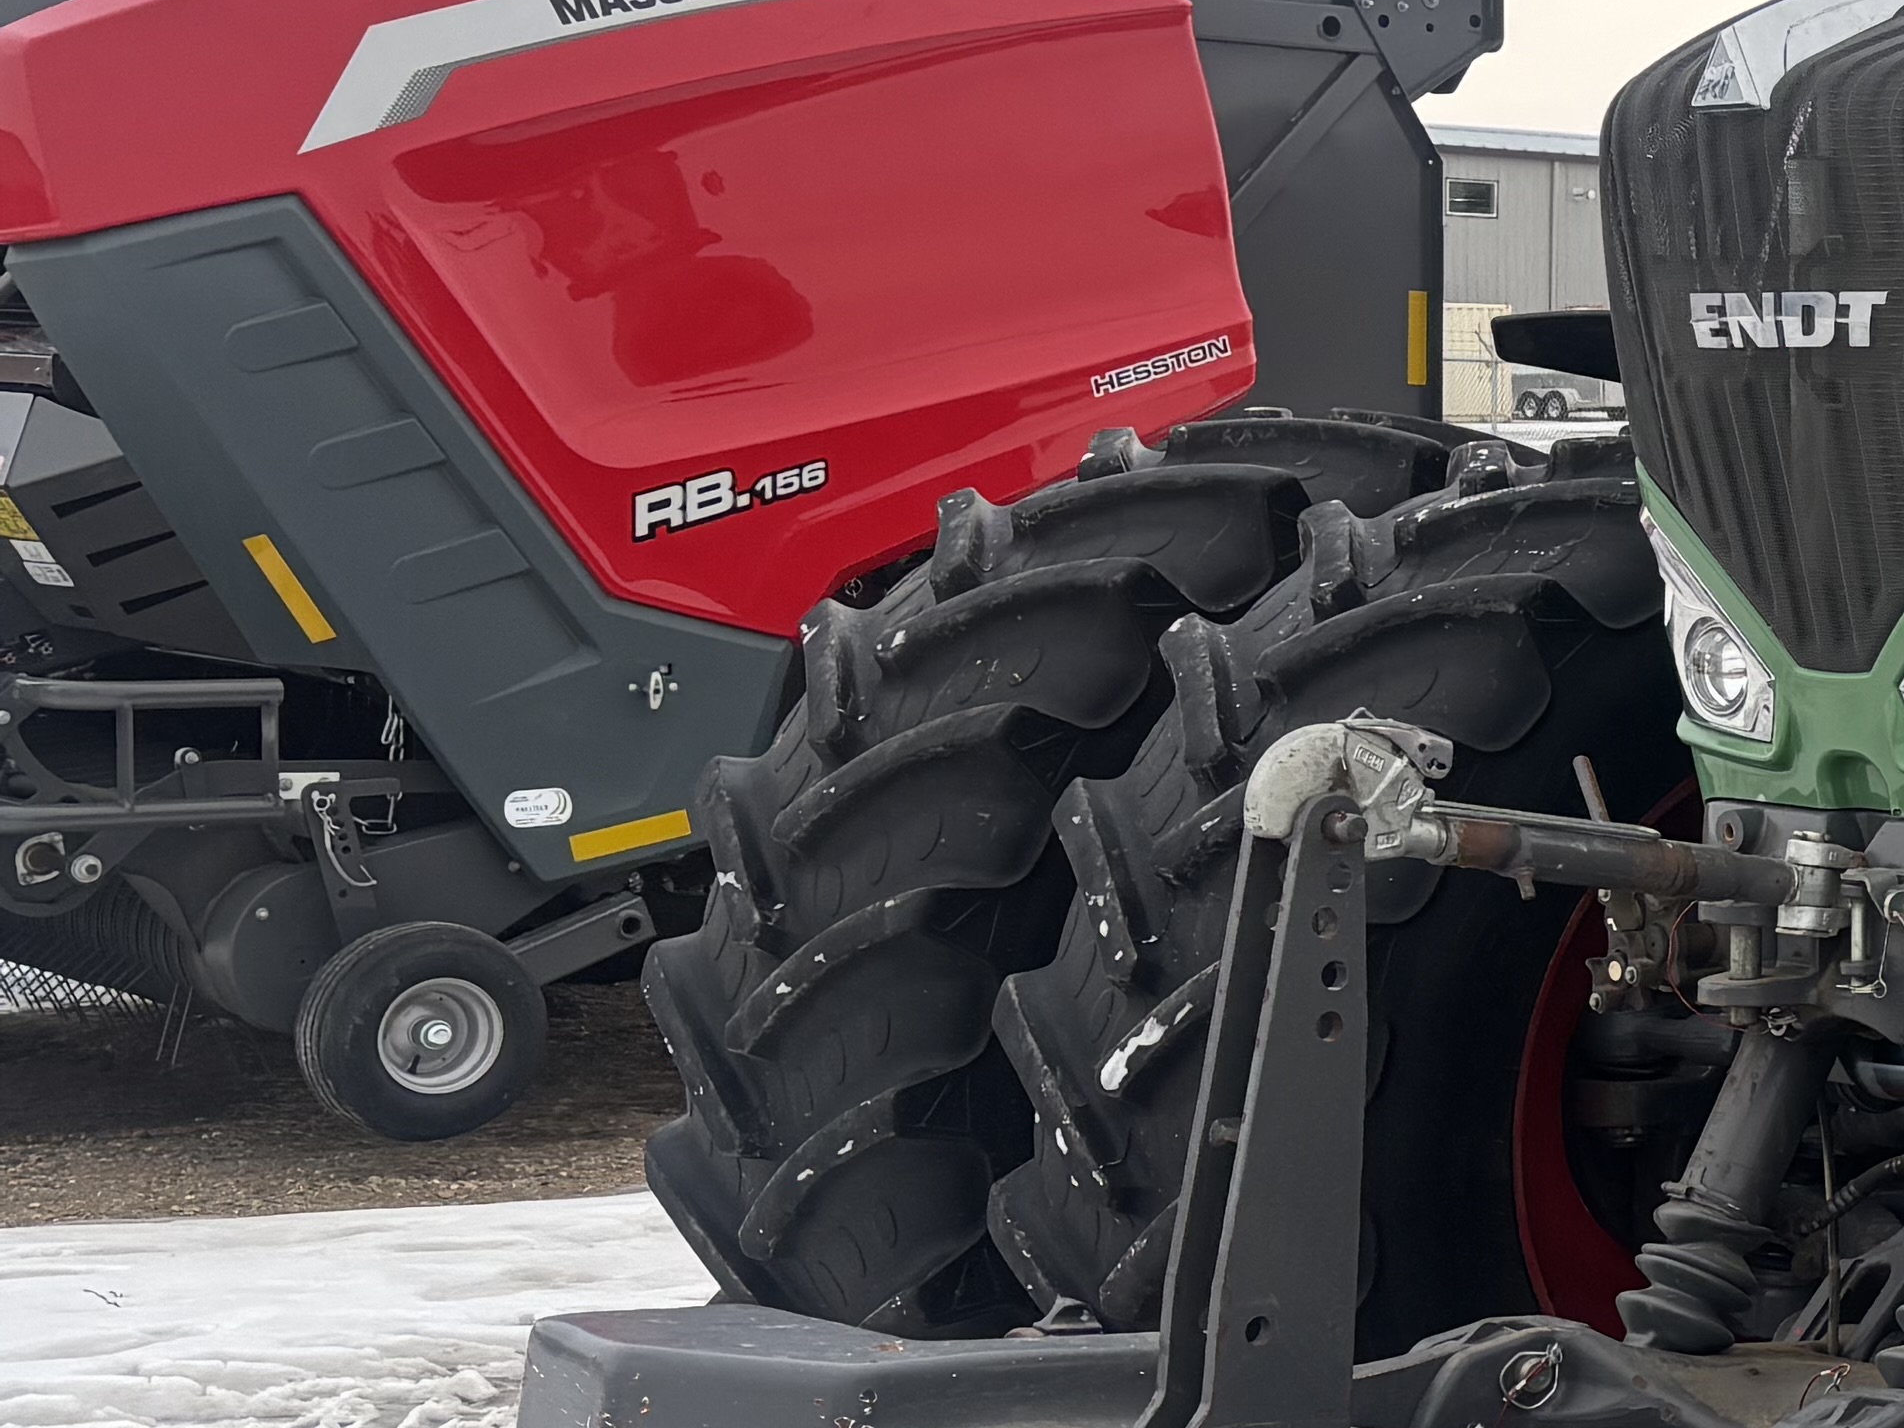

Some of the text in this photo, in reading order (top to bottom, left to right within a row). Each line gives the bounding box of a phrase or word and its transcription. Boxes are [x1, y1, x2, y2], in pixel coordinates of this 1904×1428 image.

[1689, 290, 1889, 350] ENDT
[1091, 335, 1232, 398] HESSTON
[632, 458, 829, 542] RB.156
